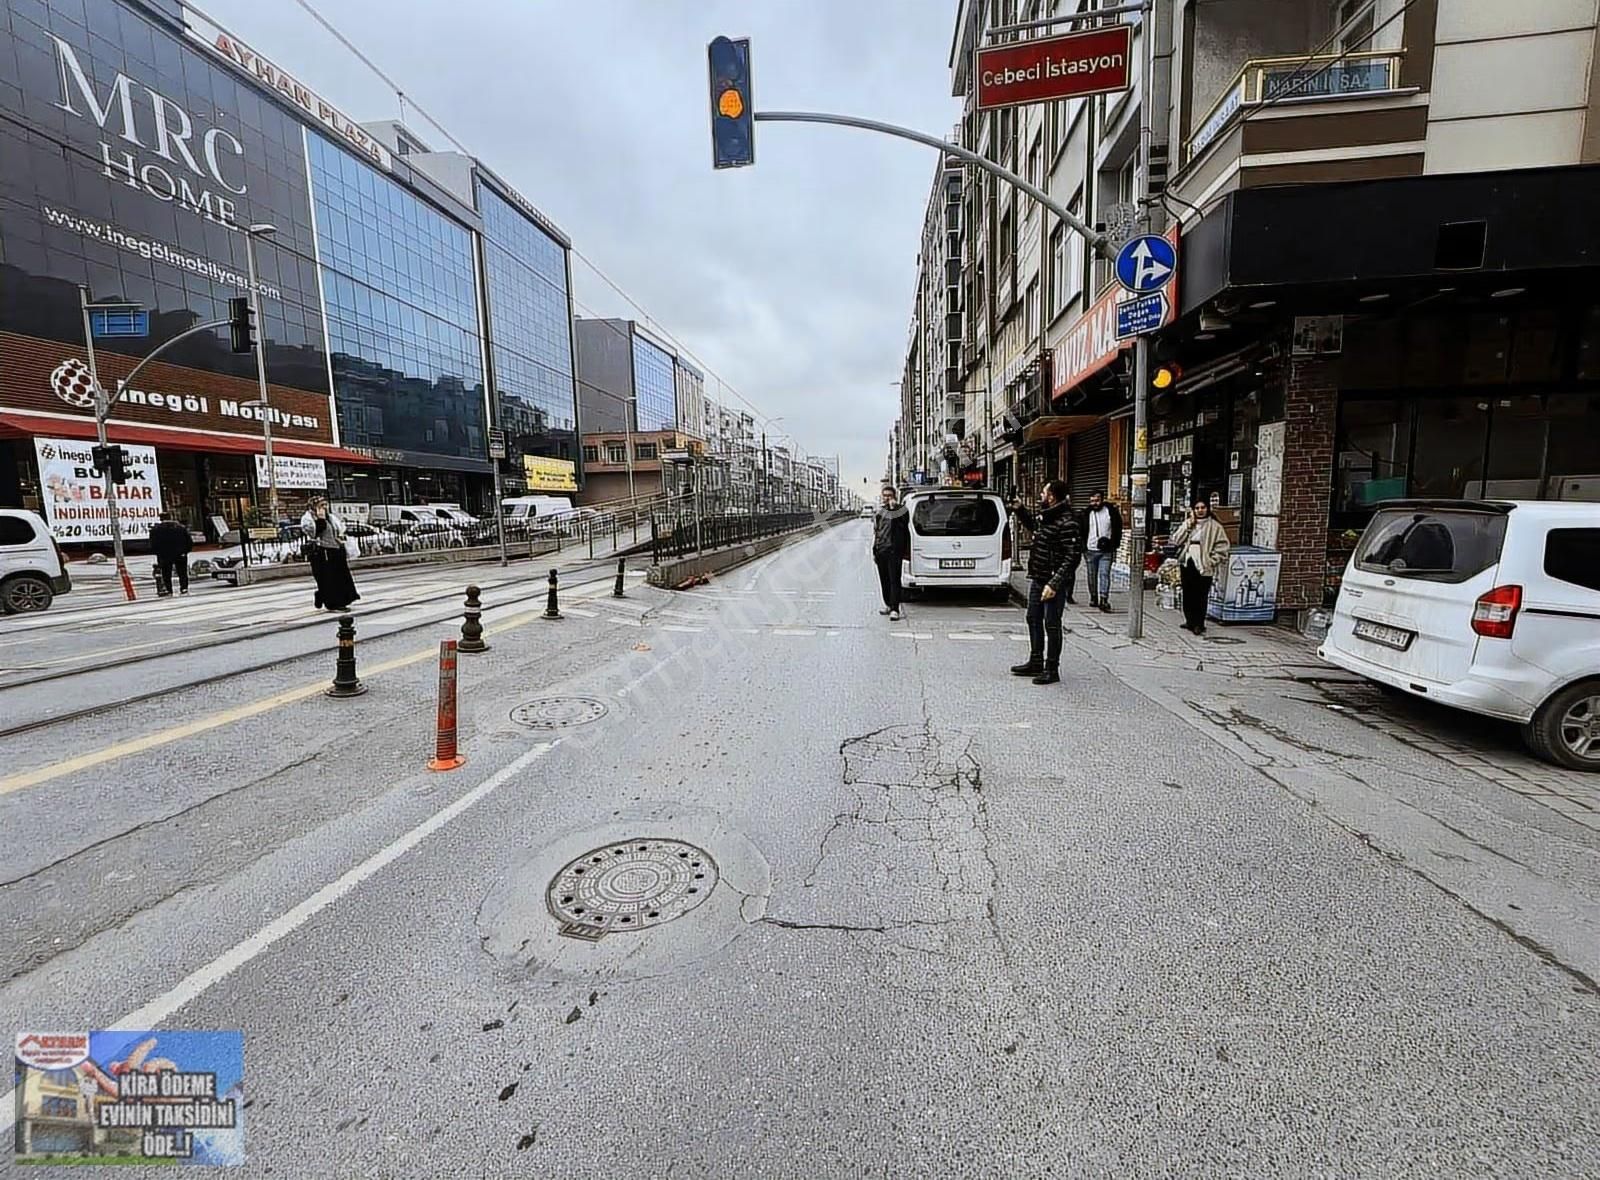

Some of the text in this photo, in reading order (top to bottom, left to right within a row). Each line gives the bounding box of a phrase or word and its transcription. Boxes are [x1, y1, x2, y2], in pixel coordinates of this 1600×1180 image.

[213, 33, 384, 164] AYHAN PLAZA
[982, 52, 1123, 87] Cebeci İstasyon
[44, 30, 248, 195] MRC
[98, 141, 239, 231] HOME
[1053, 320, 1089, 390] YAVUZ
[220, 398, 319, 429] Mobilyası
[58, 445, 92, 464] İnegö
